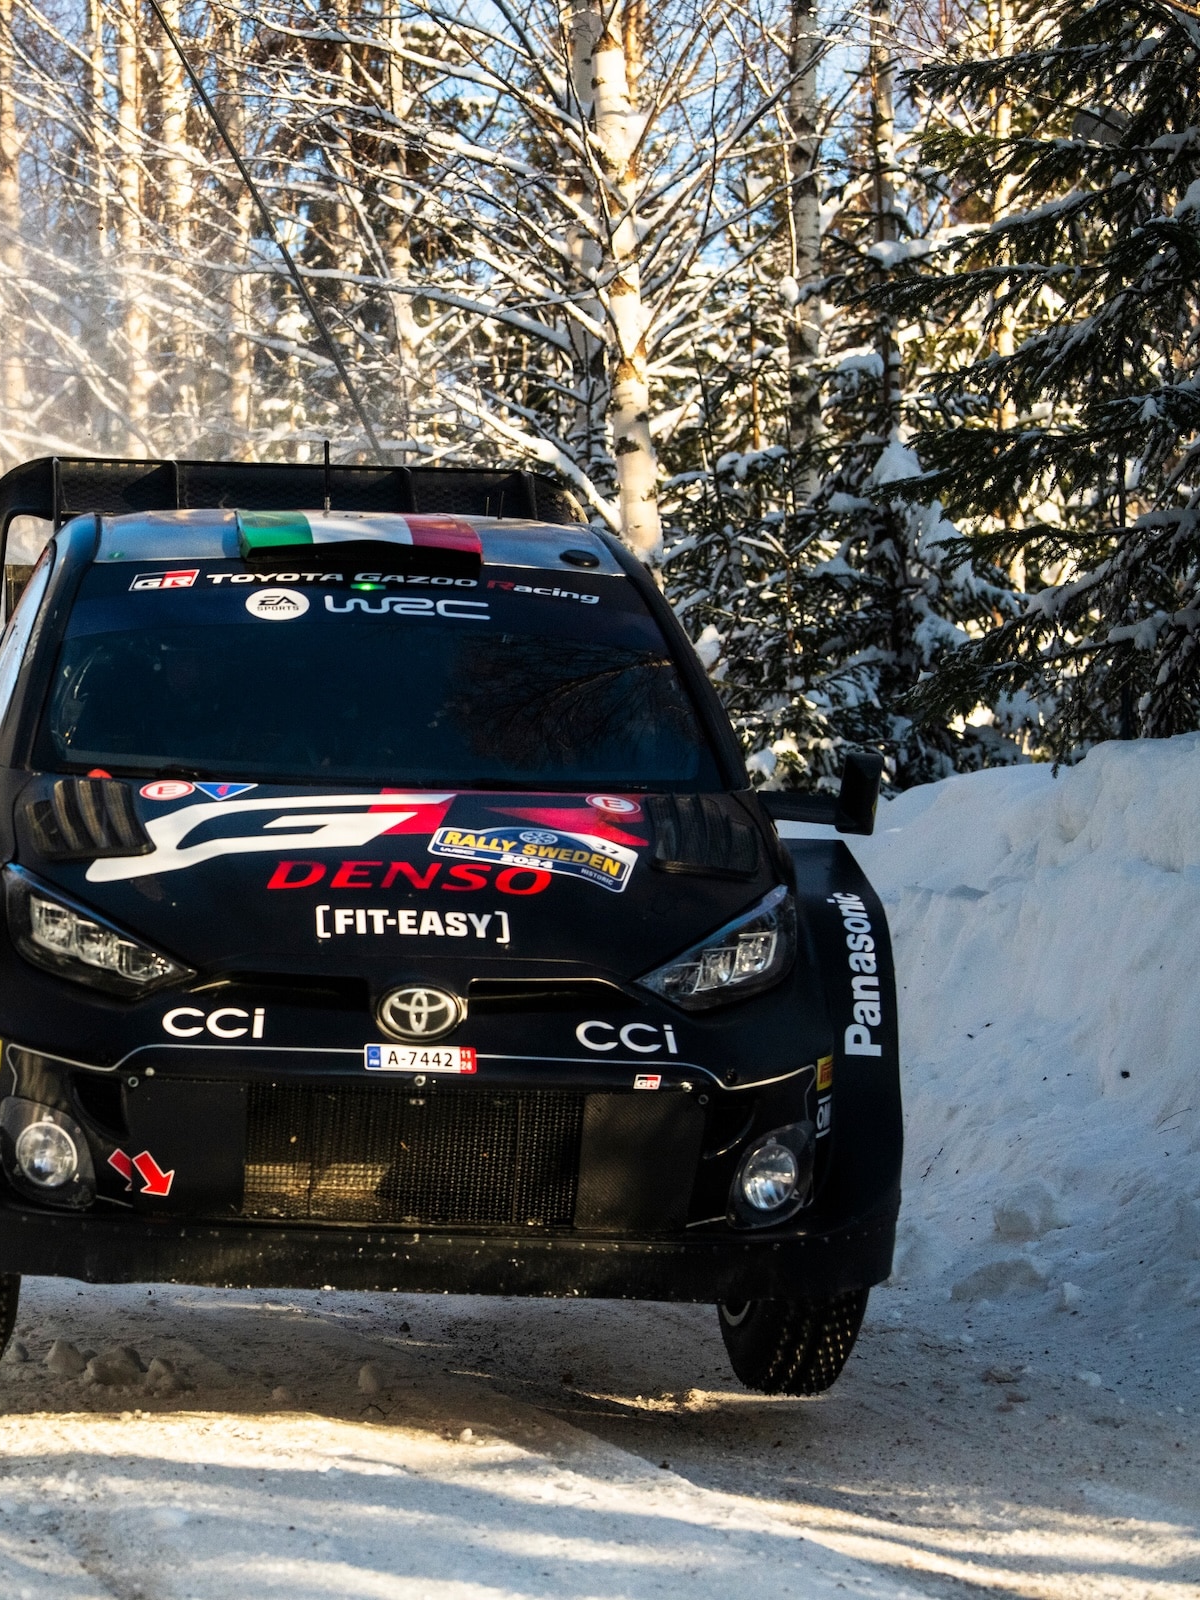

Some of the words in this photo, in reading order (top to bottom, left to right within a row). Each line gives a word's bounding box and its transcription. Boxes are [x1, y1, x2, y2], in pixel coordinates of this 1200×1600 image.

[132, 574, 195, 590] GR
[206, 572, 344, 585] TOYOTA
[353, 572, 478, 588] GAZOO
[487, 579, 600, 605] Racing
[258, 596, 298, 606] EA
[324, 595, 491, 620] WRC
[157, 785, 178, 795] E
[600, 797, 625, 811] E
[443, 831, 518, 852] RALLY
[522, 844, 622, 877] SWEDEN
[500, 854, 554, 869] 2024
[266, 860, 553, 896] DENSO
[580, 867, 615, 886] HISTORIC
[826, 891, 882, 1057] Panasonic
[387, 1050, 453, 1067] A-7442
[460, 1049, 472, 1059] 11
[460, 1061, 473, 1071] 24
